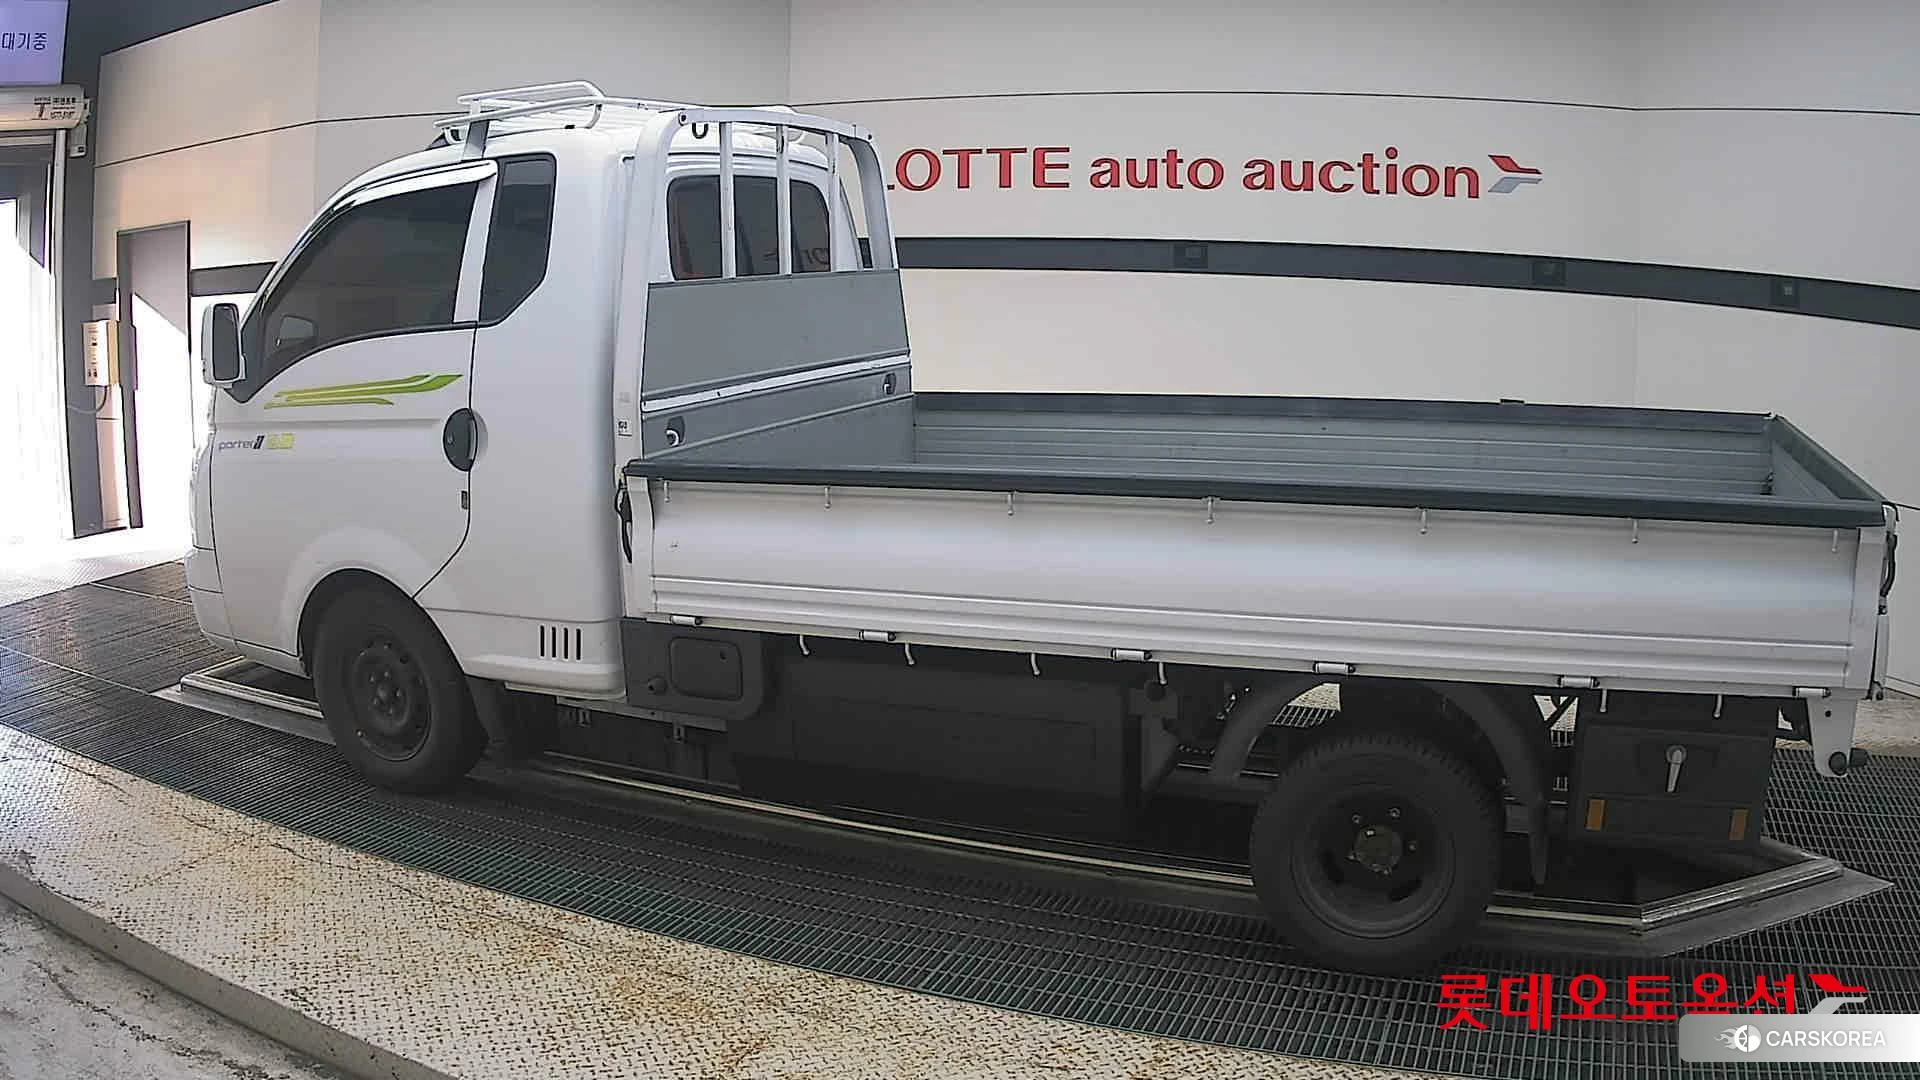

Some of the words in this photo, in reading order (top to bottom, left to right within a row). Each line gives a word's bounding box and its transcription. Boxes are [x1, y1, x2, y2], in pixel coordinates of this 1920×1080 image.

[2, 32, 48, 51] 대기중
[887, 146, 1070, 192] OTTE
[1090, 149, 1225, 190] auto
[1242, 146, 1480, 199] auction
